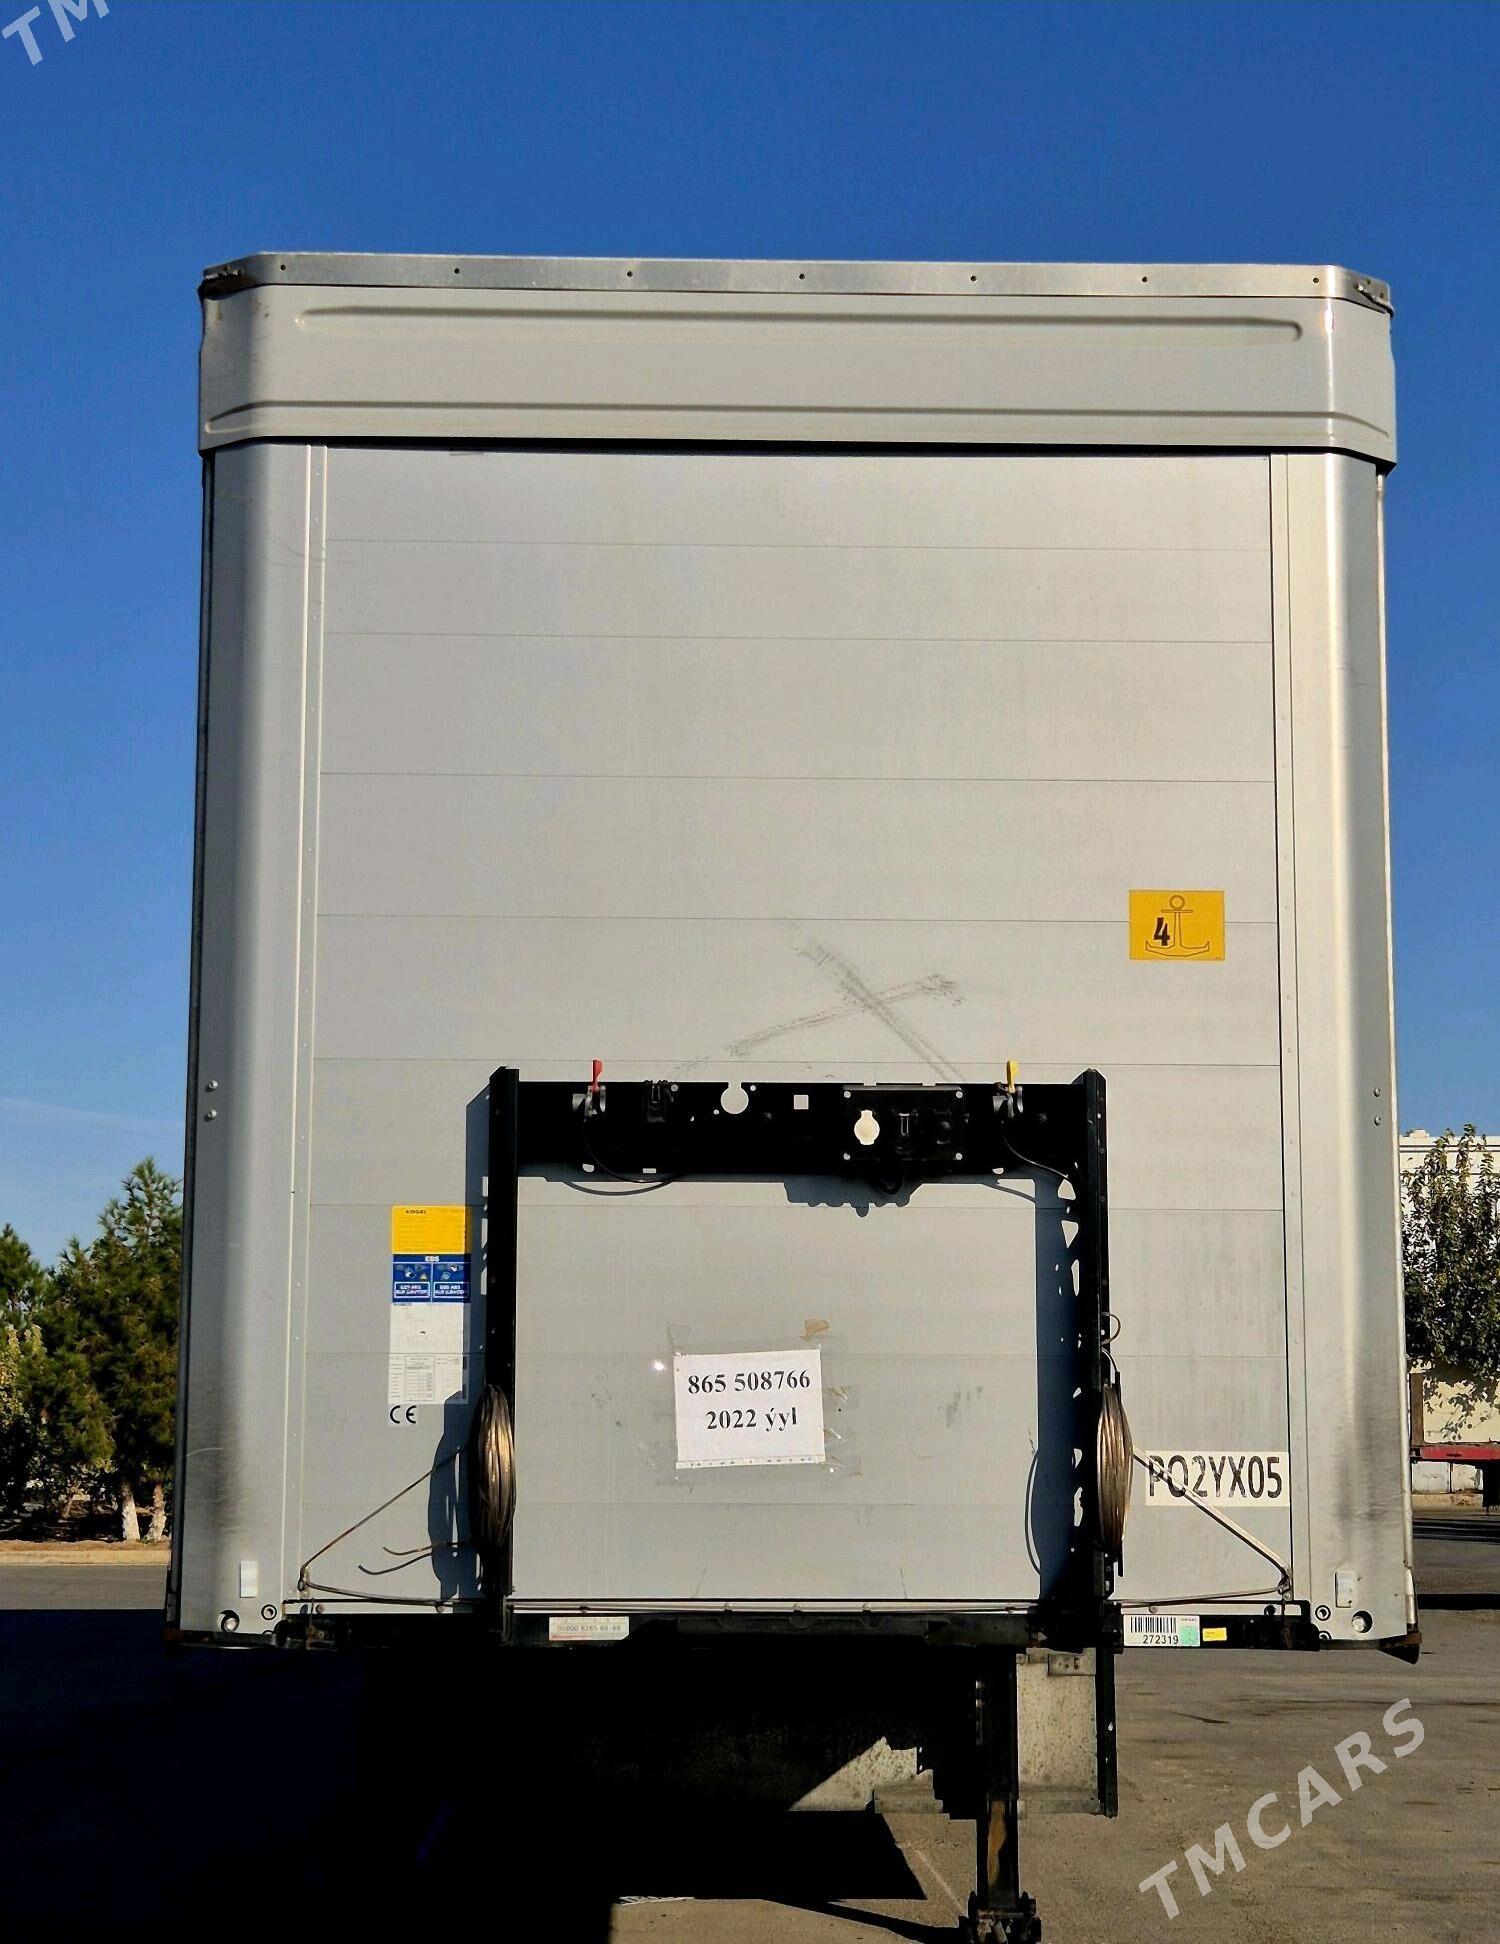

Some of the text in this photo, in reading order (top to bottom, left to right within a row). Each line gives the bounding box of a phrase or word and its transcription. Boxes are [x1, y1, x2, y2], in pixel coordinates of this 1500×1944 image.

[1152, 917, 1171, 946] 4
[687, 1369, 811, 1395] 865 508766
[706, 1407, 797, 1432] 2022 ýyl
[1142, 1634, 1179, 1645] 272319
